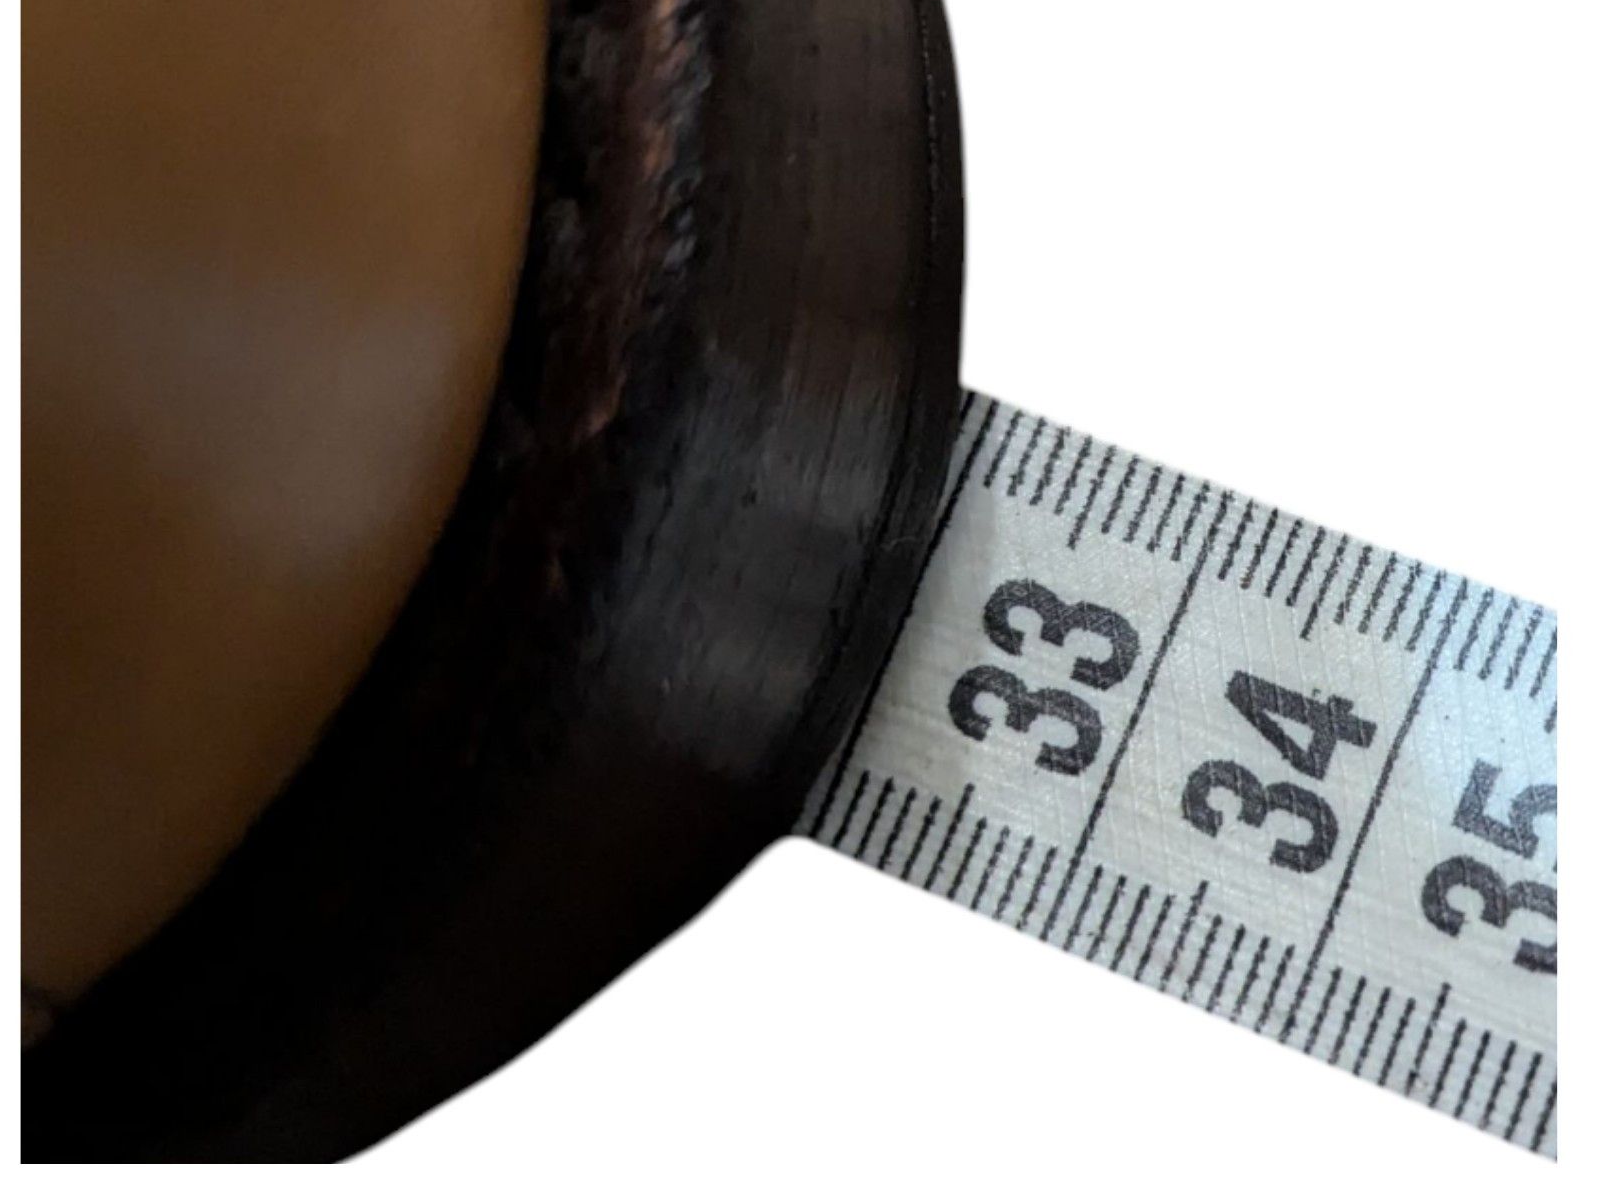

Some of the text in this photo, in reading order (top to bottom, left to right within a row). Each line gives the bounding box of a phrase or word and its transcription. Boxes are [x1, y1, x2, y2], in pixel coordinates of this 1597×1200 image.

[947, 578, 1142, 777] 33
[1181, 669, 1379, 875] 34
[1420, 761, 1557, 976] 35
